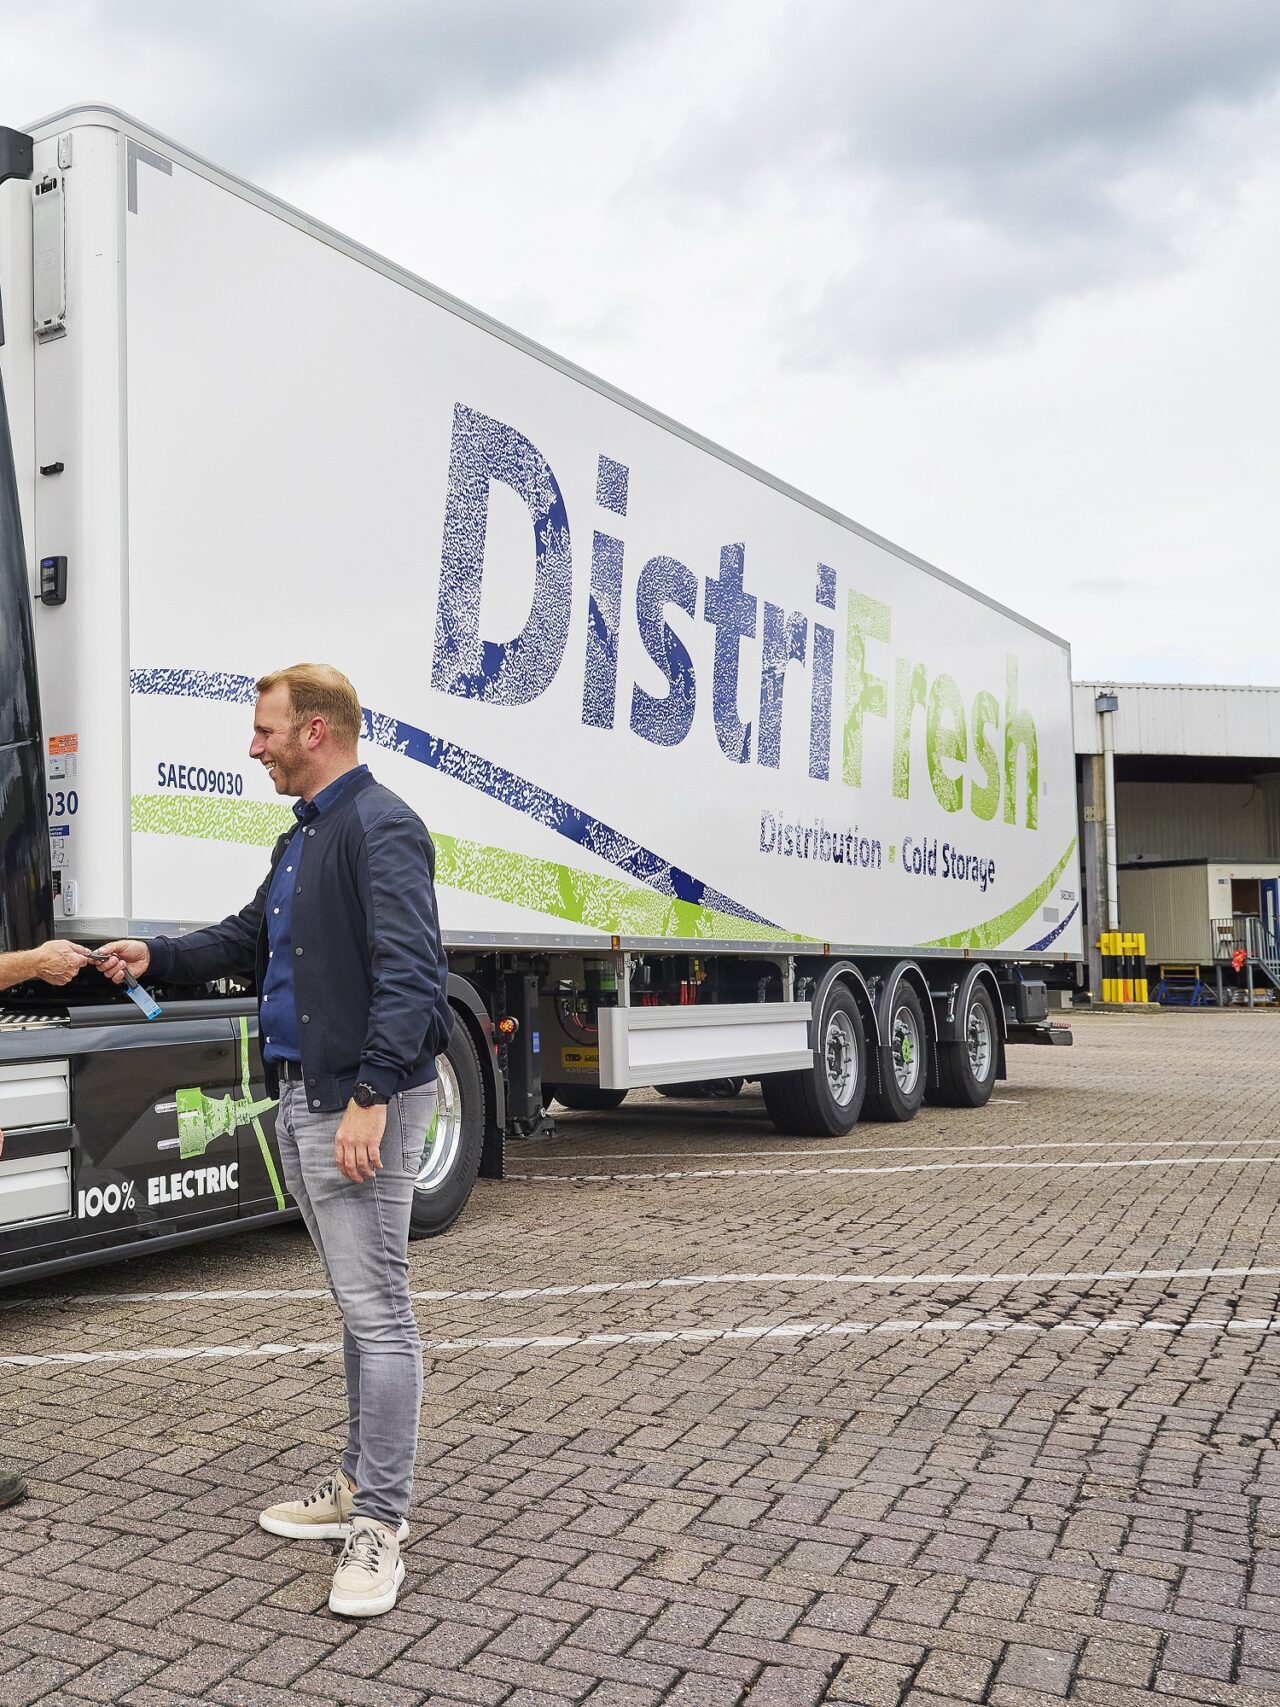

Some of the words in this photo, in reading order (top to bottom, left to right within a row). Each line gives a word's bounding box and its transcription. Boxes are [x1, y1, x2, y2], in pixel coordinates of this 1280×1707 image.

[431, 402, 1038, 831] DistriFresh
[760, 808, 881, 869] Distribution
[902, 836, 937, 876] Cold
[942, 842, 995, 892] Storage
[78, 1179, 135, 1219] 100%
[148, 1162, 239, 1206] ELECTRIC
